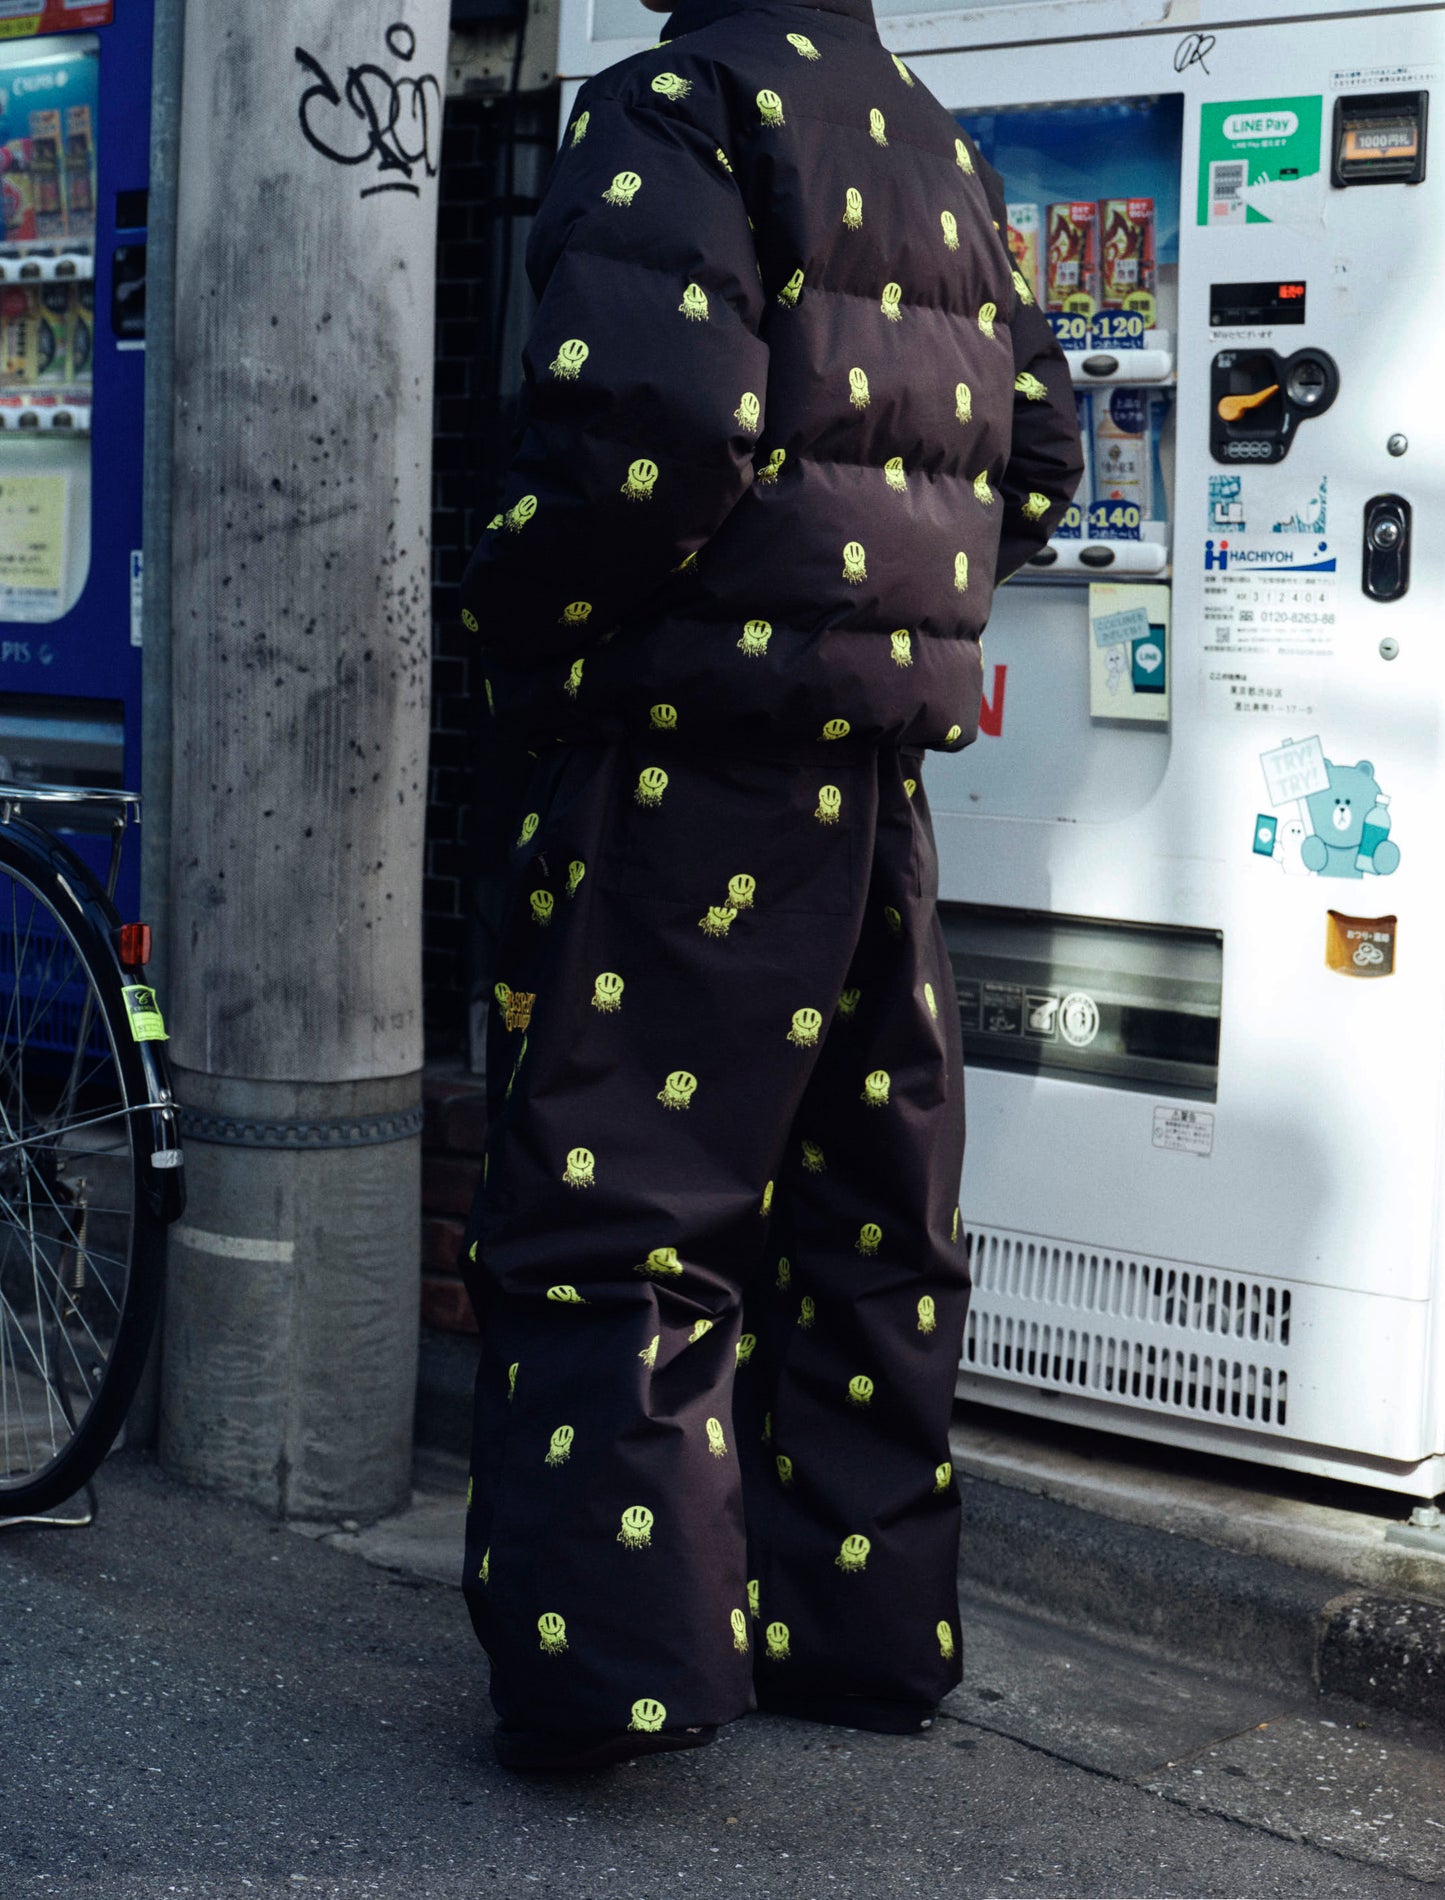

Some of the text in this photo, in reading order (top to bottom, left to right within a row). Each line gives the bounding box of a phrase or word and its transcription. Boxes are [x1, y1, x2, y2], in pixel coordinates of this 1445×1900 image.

[1232, 118, 1290, 134] LINE Pay
[1230, 550, 1293, 562] HACHIYOH
